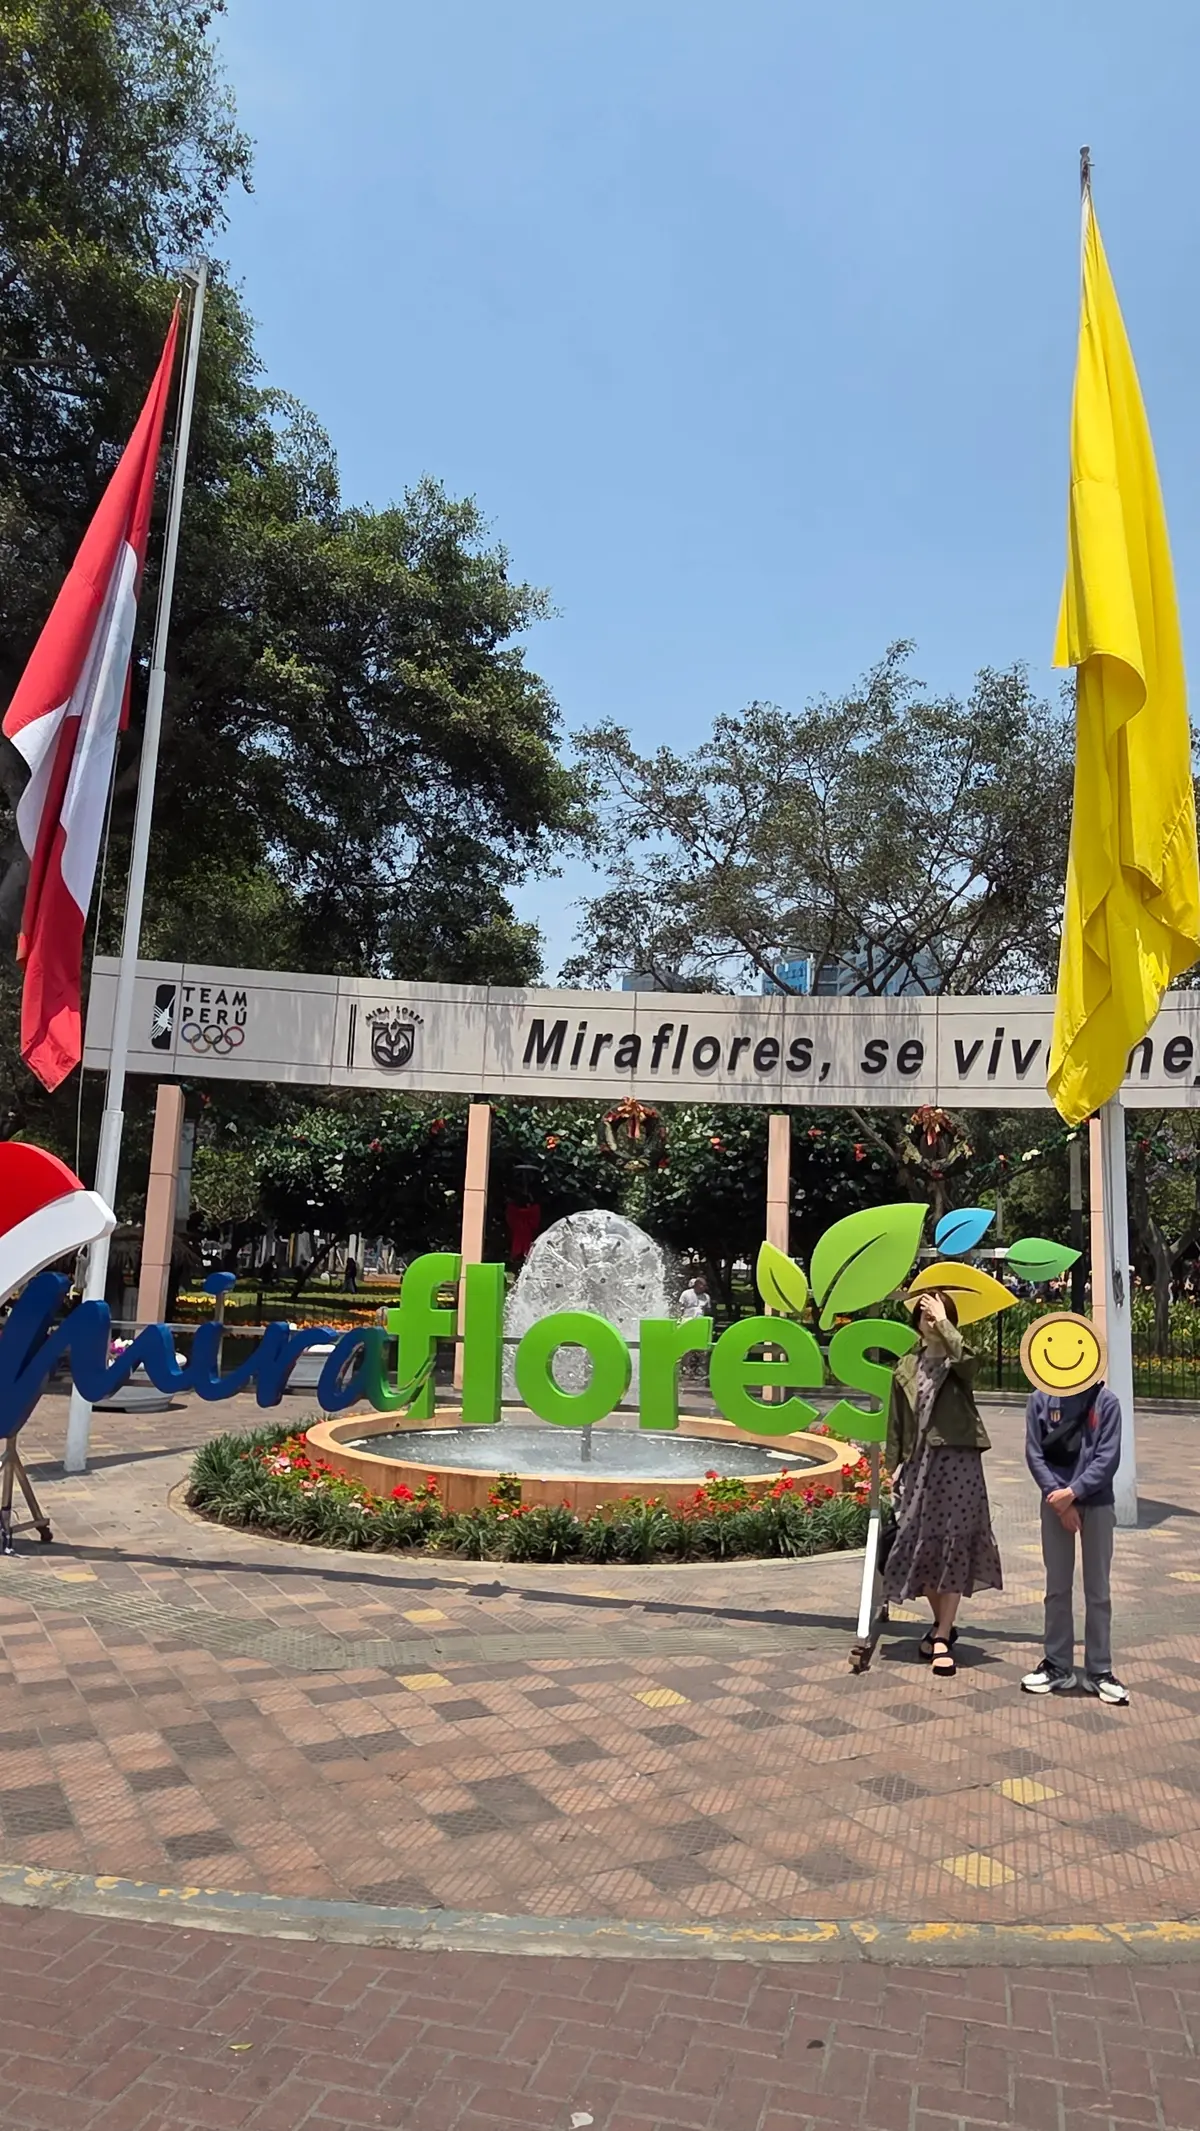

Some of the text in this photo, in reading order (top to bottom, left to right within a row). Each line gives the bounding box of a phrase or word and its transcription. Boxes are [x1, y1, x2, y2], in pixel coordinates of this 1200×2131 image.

[182, 986, 248, 1007] TEAM
[182, 1007, 248, 1026] PERÚ
[365, 1005, 425, 1025] MIRALORES
[523, 1019, 831, 1082] Miraflores,
[860, 1039, 924, 1074] se
[954, 1027, 1051, 1074] viv
